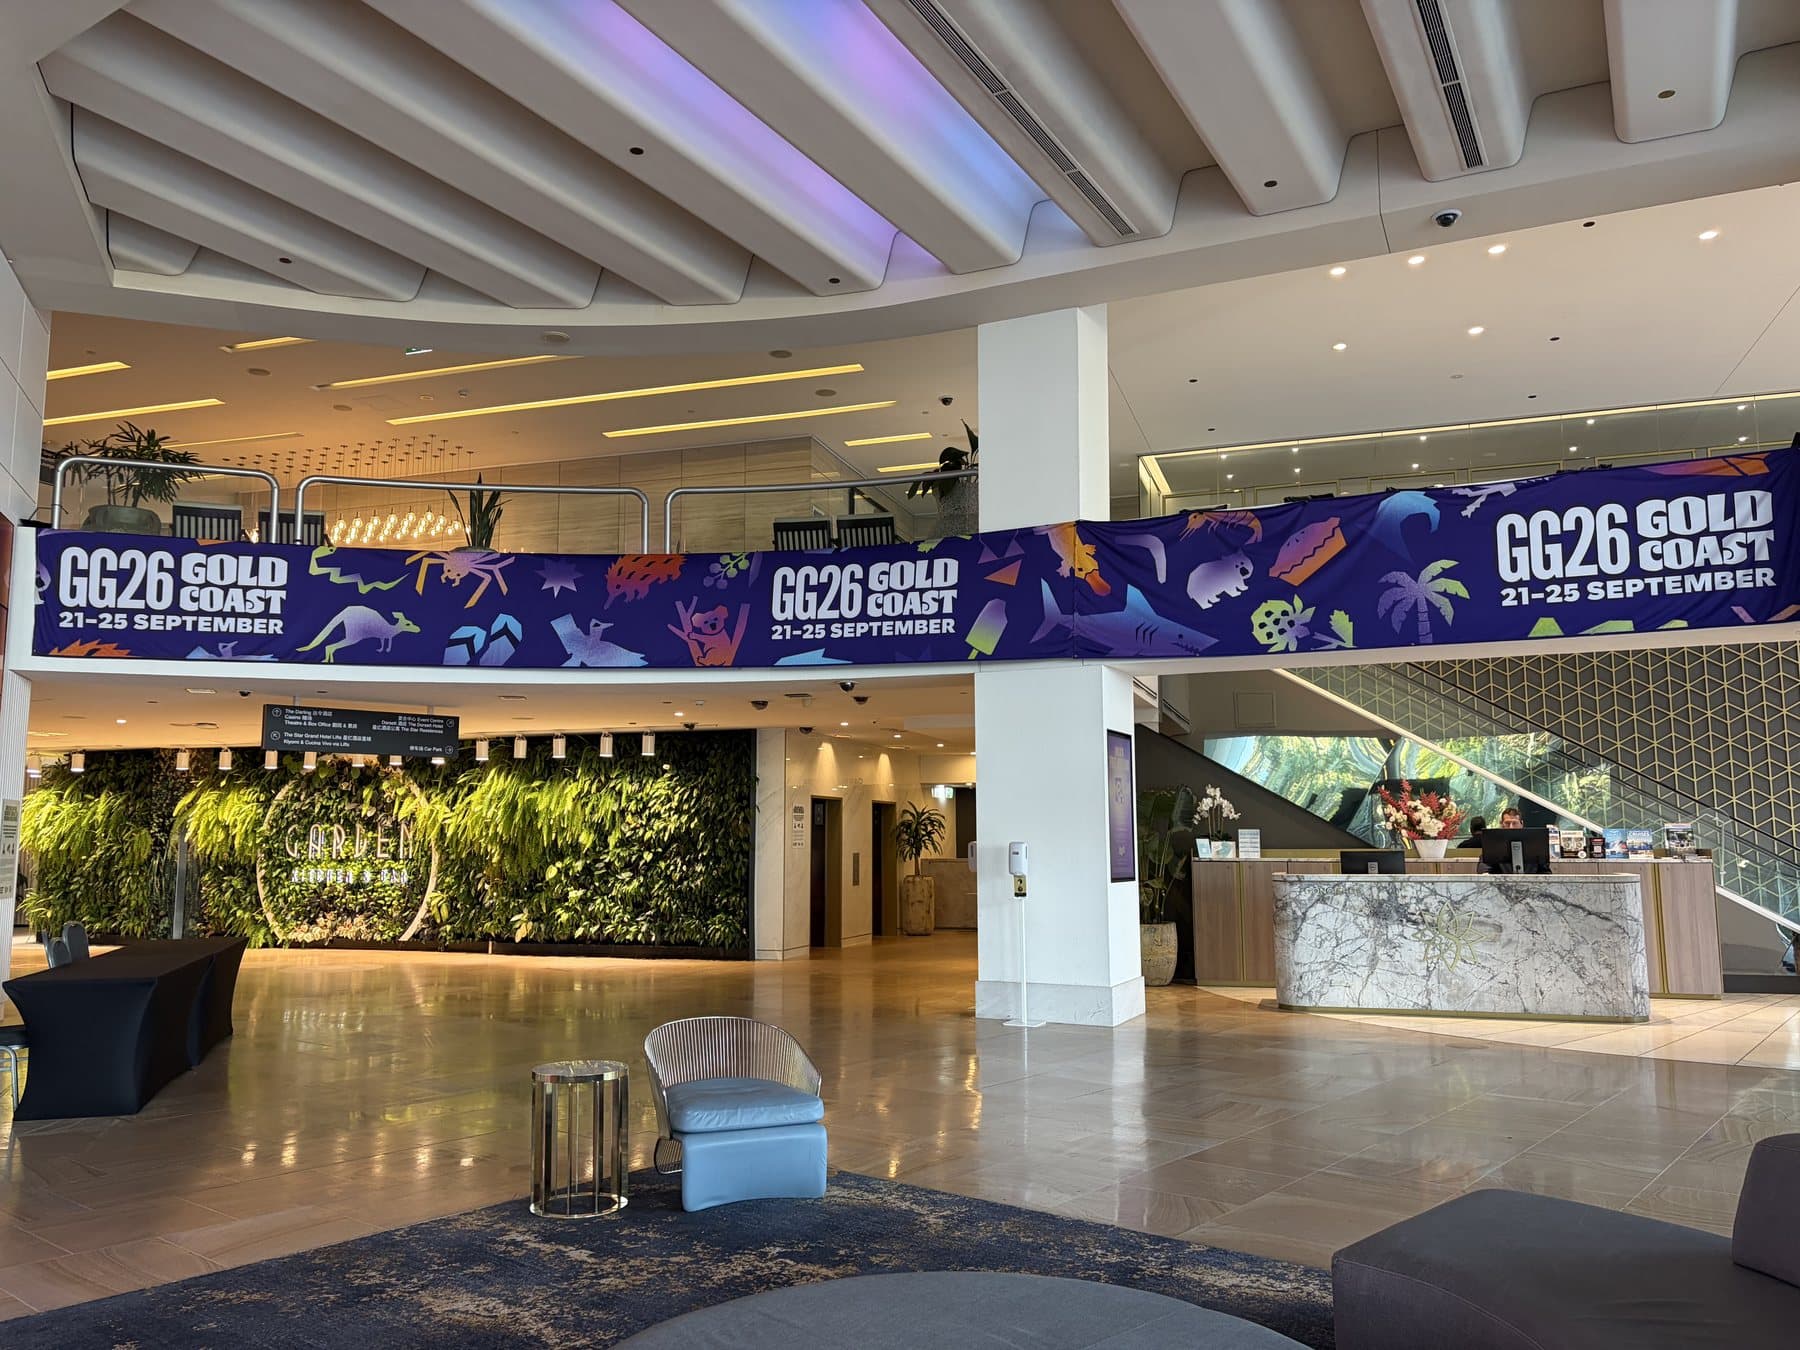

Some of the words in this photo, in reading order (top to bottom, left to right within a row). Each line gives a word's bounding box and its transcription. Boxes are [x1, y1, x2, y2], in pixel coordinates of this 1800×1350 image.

[1496, 503, 1631, 583] GG26
[1636, 490, 1773, 538] GOLD
[1638, 529, 1775, 572] COAST
[58, 546, 175, 610] GG26
[180, 552, 288, 587] GOLD
[771, 563, 864, 621] GG26
[868, 558, 959, 592] GOLD
[1586, 567, 1777, 600] SEPTEMBER
[179, 585, 288, 614] COAST
[866, 589, 958, 617] COAST
[133, 613, 284, 635] SEPTEMBER
[830, 618, 956, 638] SEPTEMBER
[285, 823, 413, 859] GARDEN
